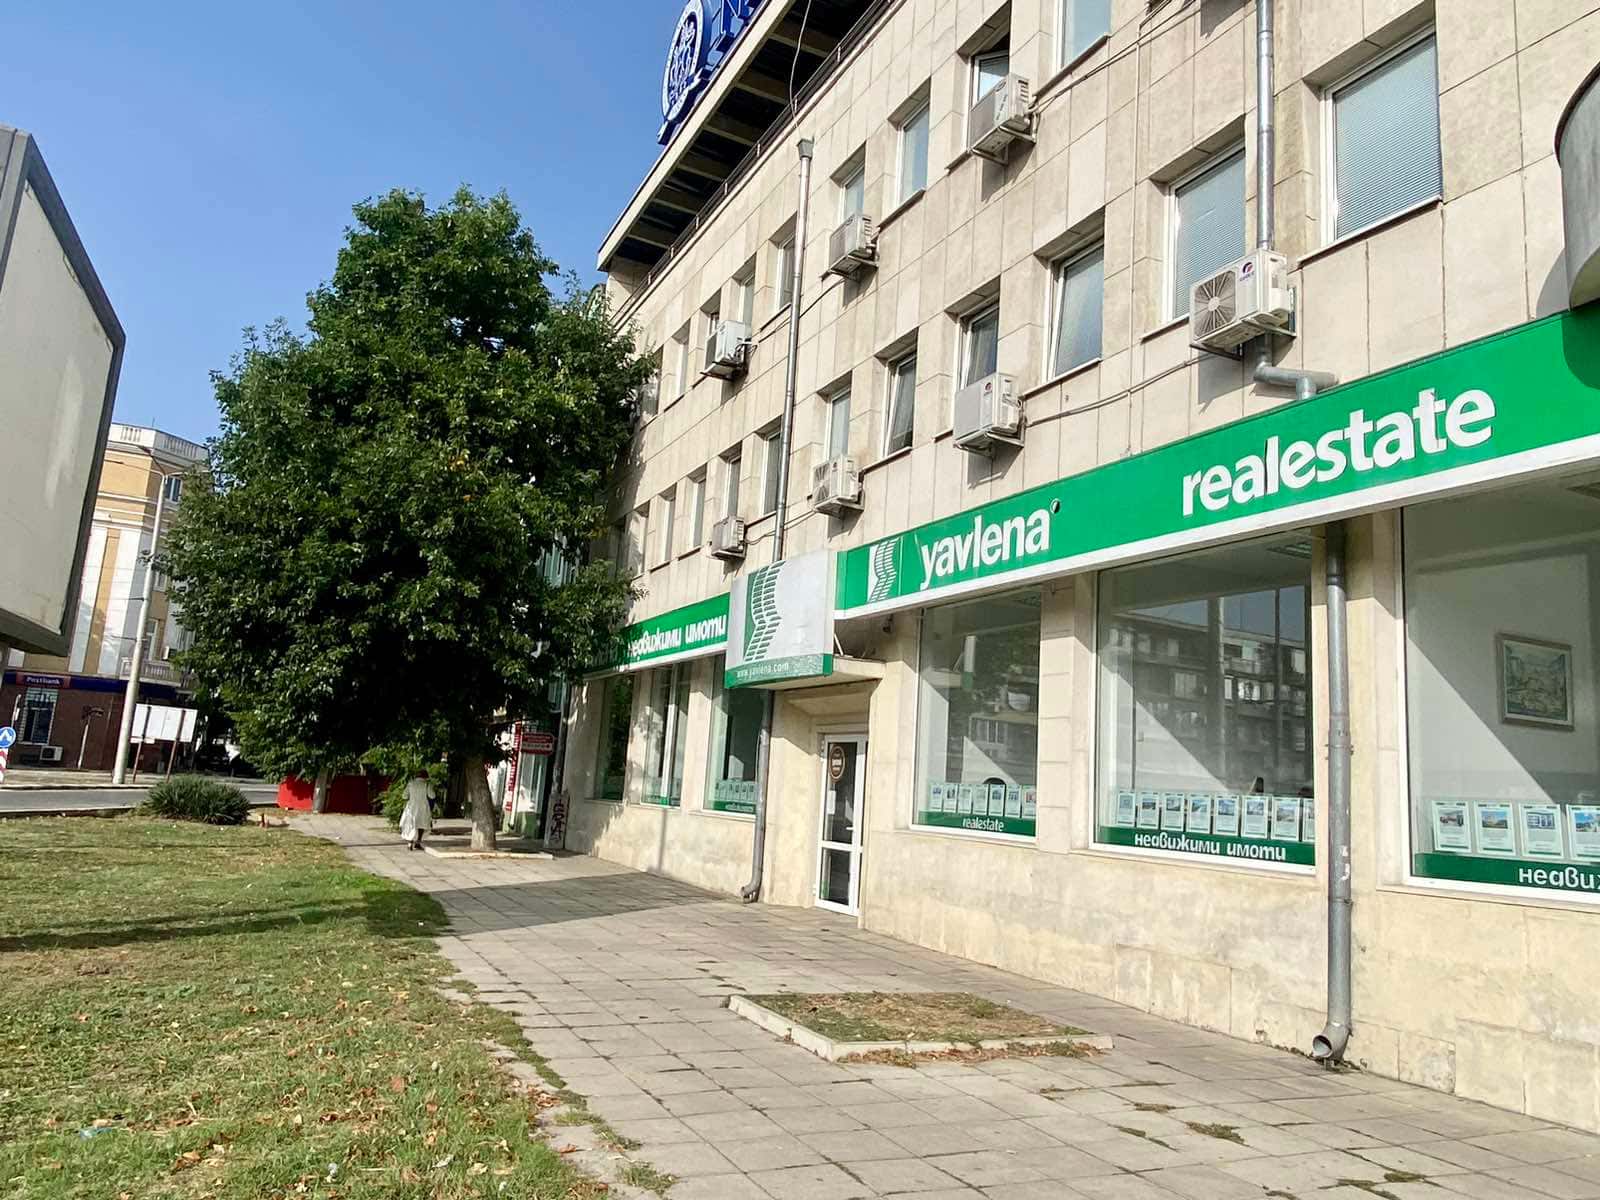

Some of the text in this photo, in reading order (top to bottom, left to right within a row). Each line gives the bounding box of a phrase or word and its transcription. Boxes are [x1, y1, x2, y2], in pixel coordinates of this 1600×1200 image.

[1182, 388, 1496, 517] realestate
[919, 508, 1050, 590] yavlena
[962, 817, 1005, 832] realestate
[1518, 866, 1600, 890] недви
